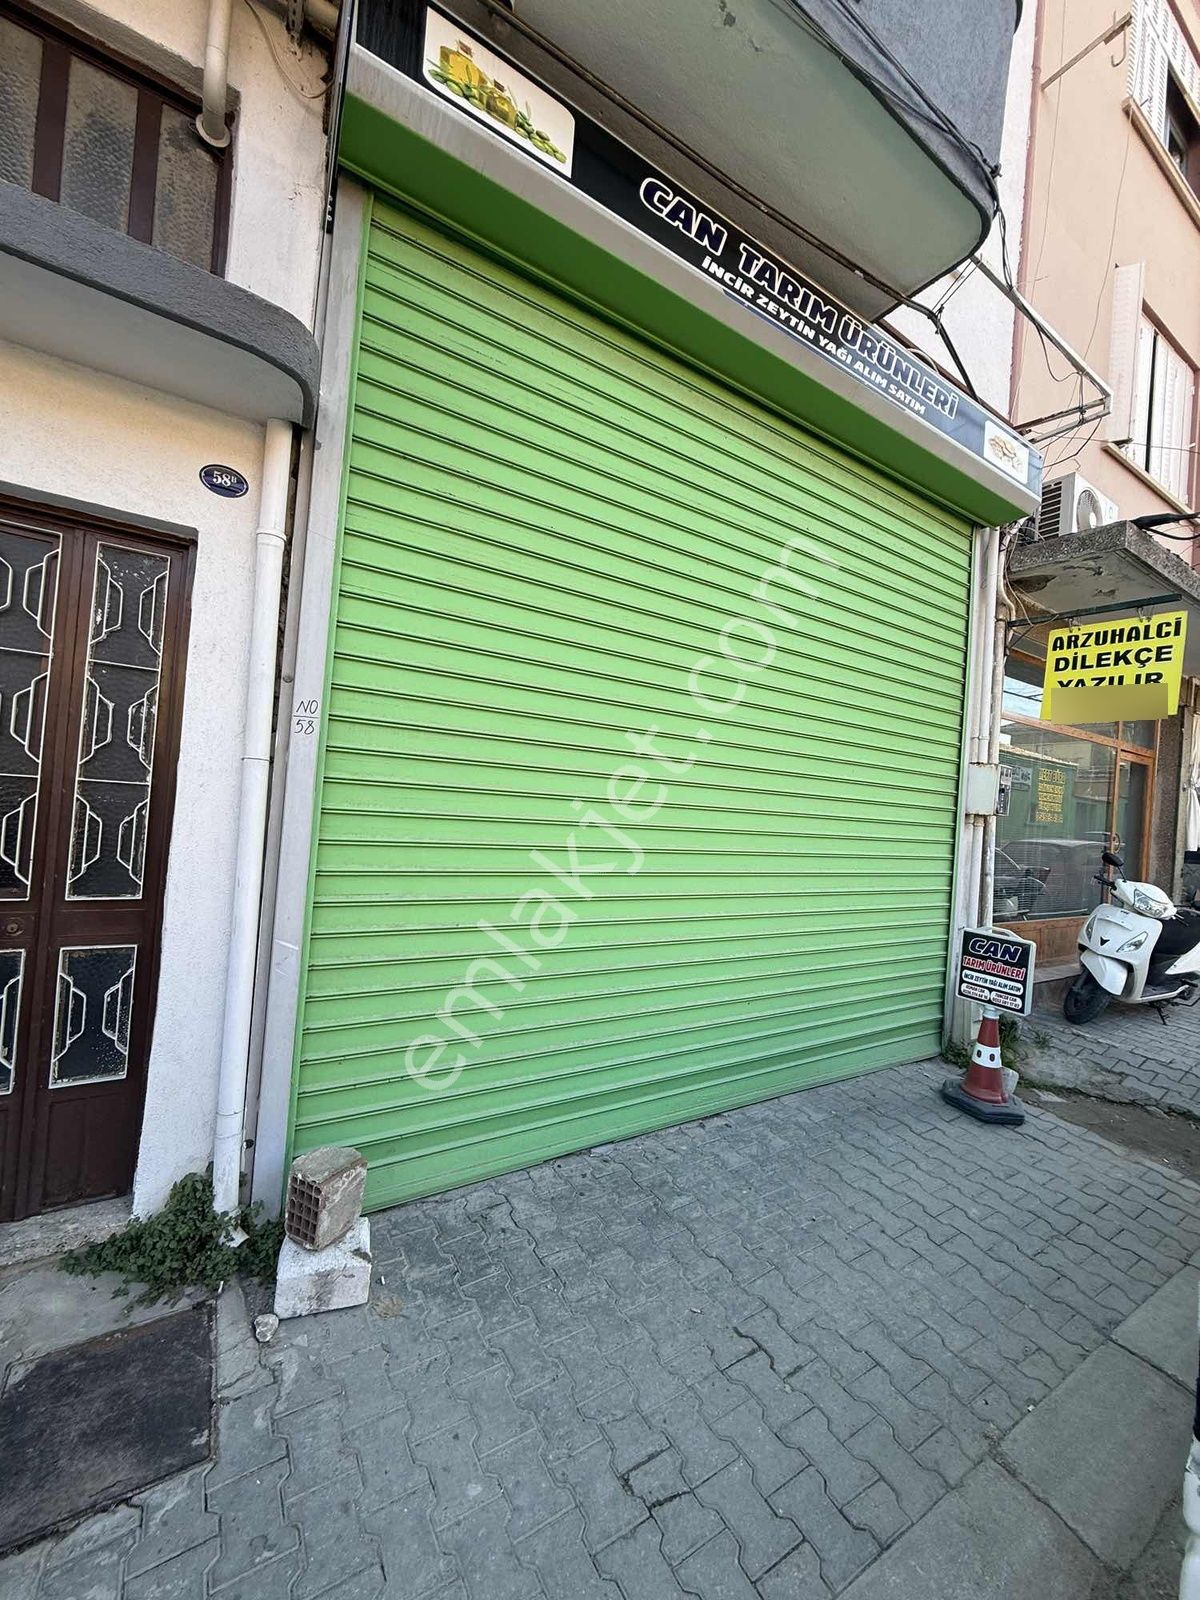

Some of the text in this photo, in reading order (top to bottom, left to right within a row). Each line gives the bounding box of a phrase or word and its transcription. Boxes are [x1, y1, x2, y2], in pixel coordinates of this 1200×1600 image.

[640, 177, 960, 419] CAN TARIM ÜRÜNLERİ
[701, 256, 926, 416] İNCİR ZEYTİN YAĞI ALIM SATIM
[1052, 617, 1182, 652] ARZUHALCİ
[1054, 645, 1174, 672] DİLEKÇE
[296, 699, 318, 714] NO
[294, 719, 315, 735] 58
[969, 937, 1022, 963] CAN
[962, 955, 1026, 981] TARIM ÜRÜNLERİ
